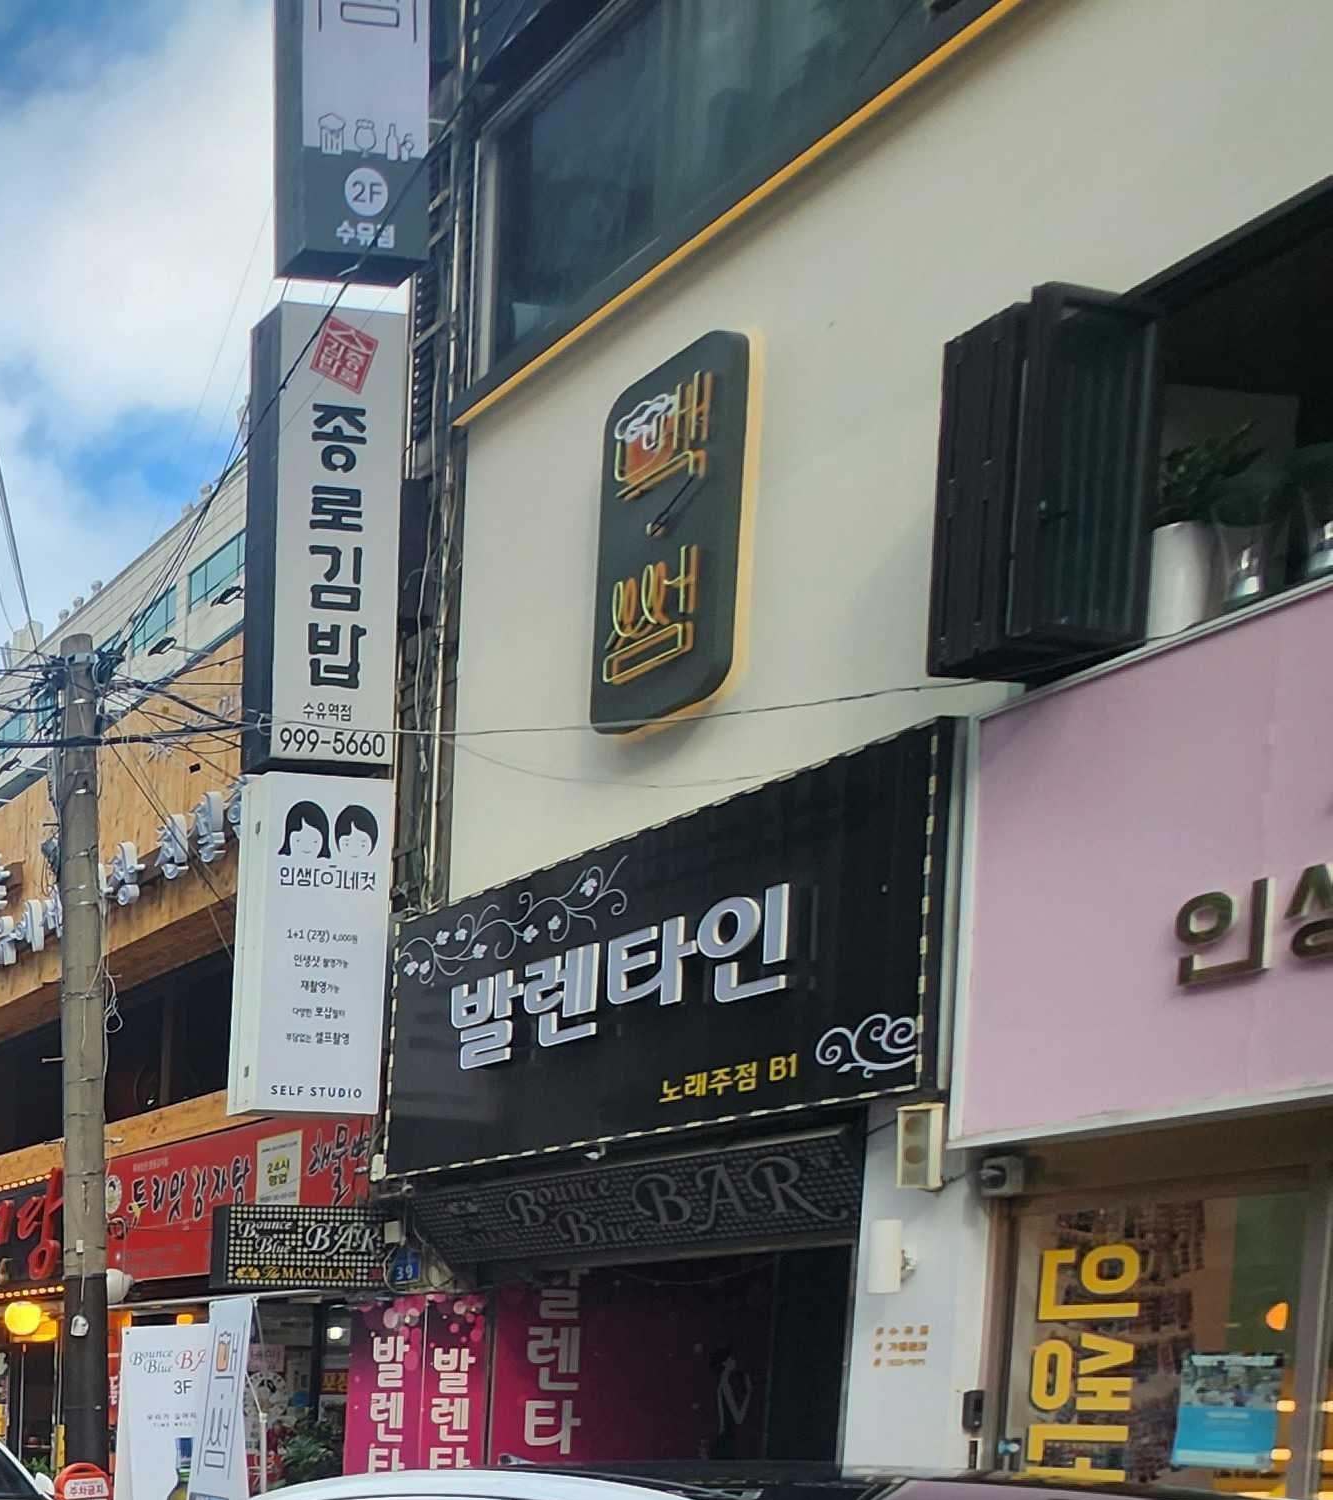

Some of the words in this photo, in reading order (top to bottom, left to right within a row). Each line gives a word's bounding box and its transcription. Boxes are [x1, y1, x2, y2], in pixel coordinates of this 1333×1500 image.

[352, 180, 384, 203] 2F
[335, 222, 396, 249] 수유점
[308, 402, 368, 690] 종로김밥
[302, 702, 353, 722] 수유역점
[279, 728, 386, 759] 999-5660
[450, 879, 791, 1071] 발렌타인
[661, 1060, 759, 1105] 노래주점
[768, 1053, 798, 1082] B1
[270, 1084, 304, 1097] SELF
[309, 1085, 363, 1099] STUDIO
[266, 1158, 291, 1174] 24시
[268, 1173, 288, 1187] 영업
[506, 1177, 613, 1228] Bounce
[632, 1155, 850, 1235] BAR
[237, 1220, 293, 1239] Bounce
[553, 1209, 639, 1246] Blue
[254, 1234, 292, 1254] Blue
[304, 1222, 379, 1257] BAR
[282, 1266, 356, 1281] MACALLAN
[394, 1265, 415, 1281] 39
[130, 1348, 174, 1367] Bounce
[143, 1359, 174, 1374] Blue
[173, 1379, 194, 1395] 3F
